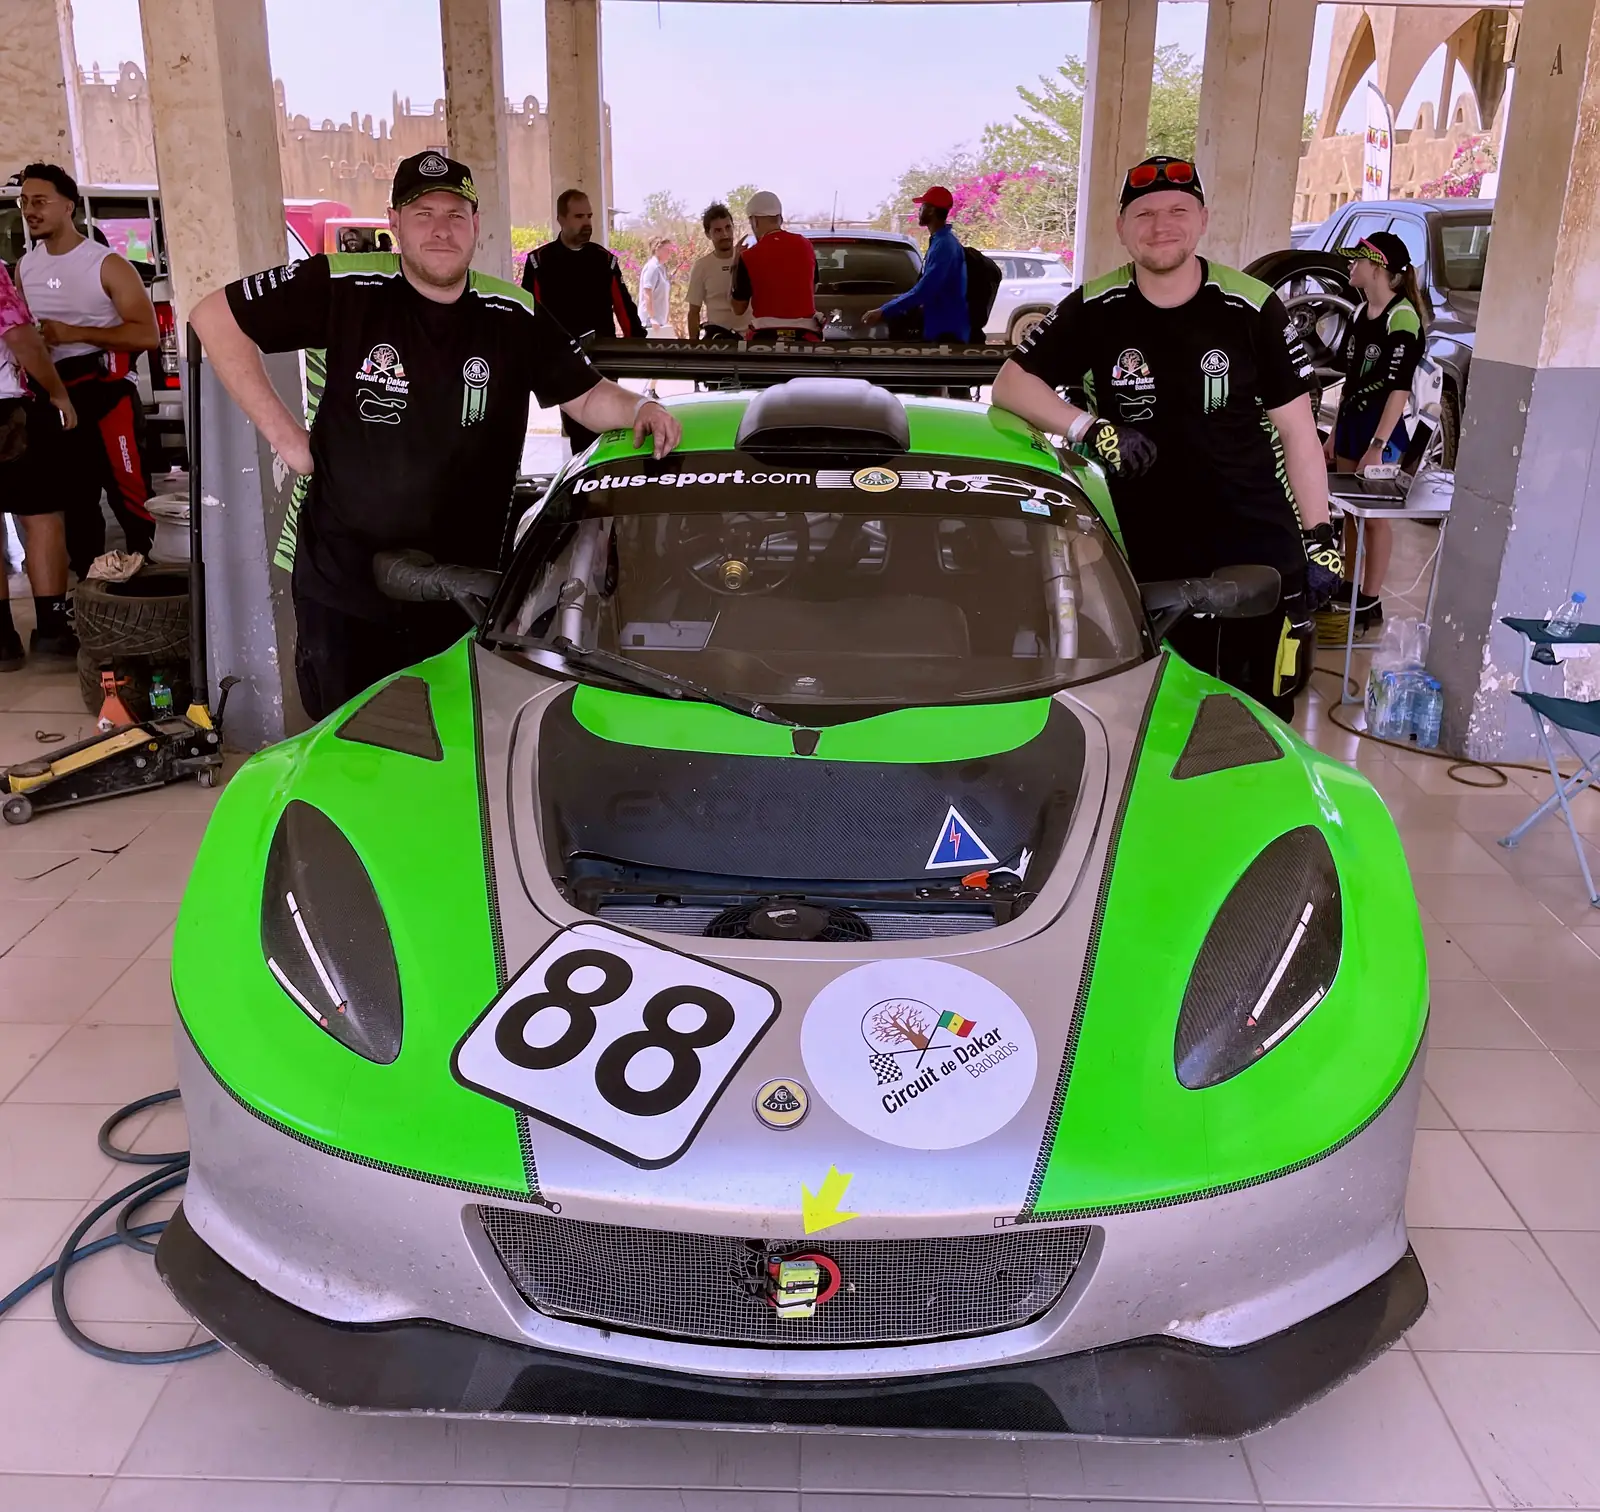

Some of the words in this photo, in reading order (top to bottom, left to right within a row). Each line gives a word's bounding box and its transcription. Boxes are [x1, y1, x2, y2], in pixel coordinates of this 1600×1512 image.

[1550, 44, 1563, 77] A
[355, 372, 378, 383] Circuit
[387, 377, 409, 388] Dakar
[1135, 376, 1155, 384] Dakar
[572, 469, 811, 495] lotus-sport.com
[859, 477, 895, 487] LOTUS
[495, 949, 736, 1117] 88
[881, 1066, 940, 1114] Circuit
[940, 1060, 957, 1076] de
[952, 1027, 1002, 1065] Dakar
[965, 1040, 1019, 1079] Baobabs
[764, 1099, 799, 1111] LOTUS
